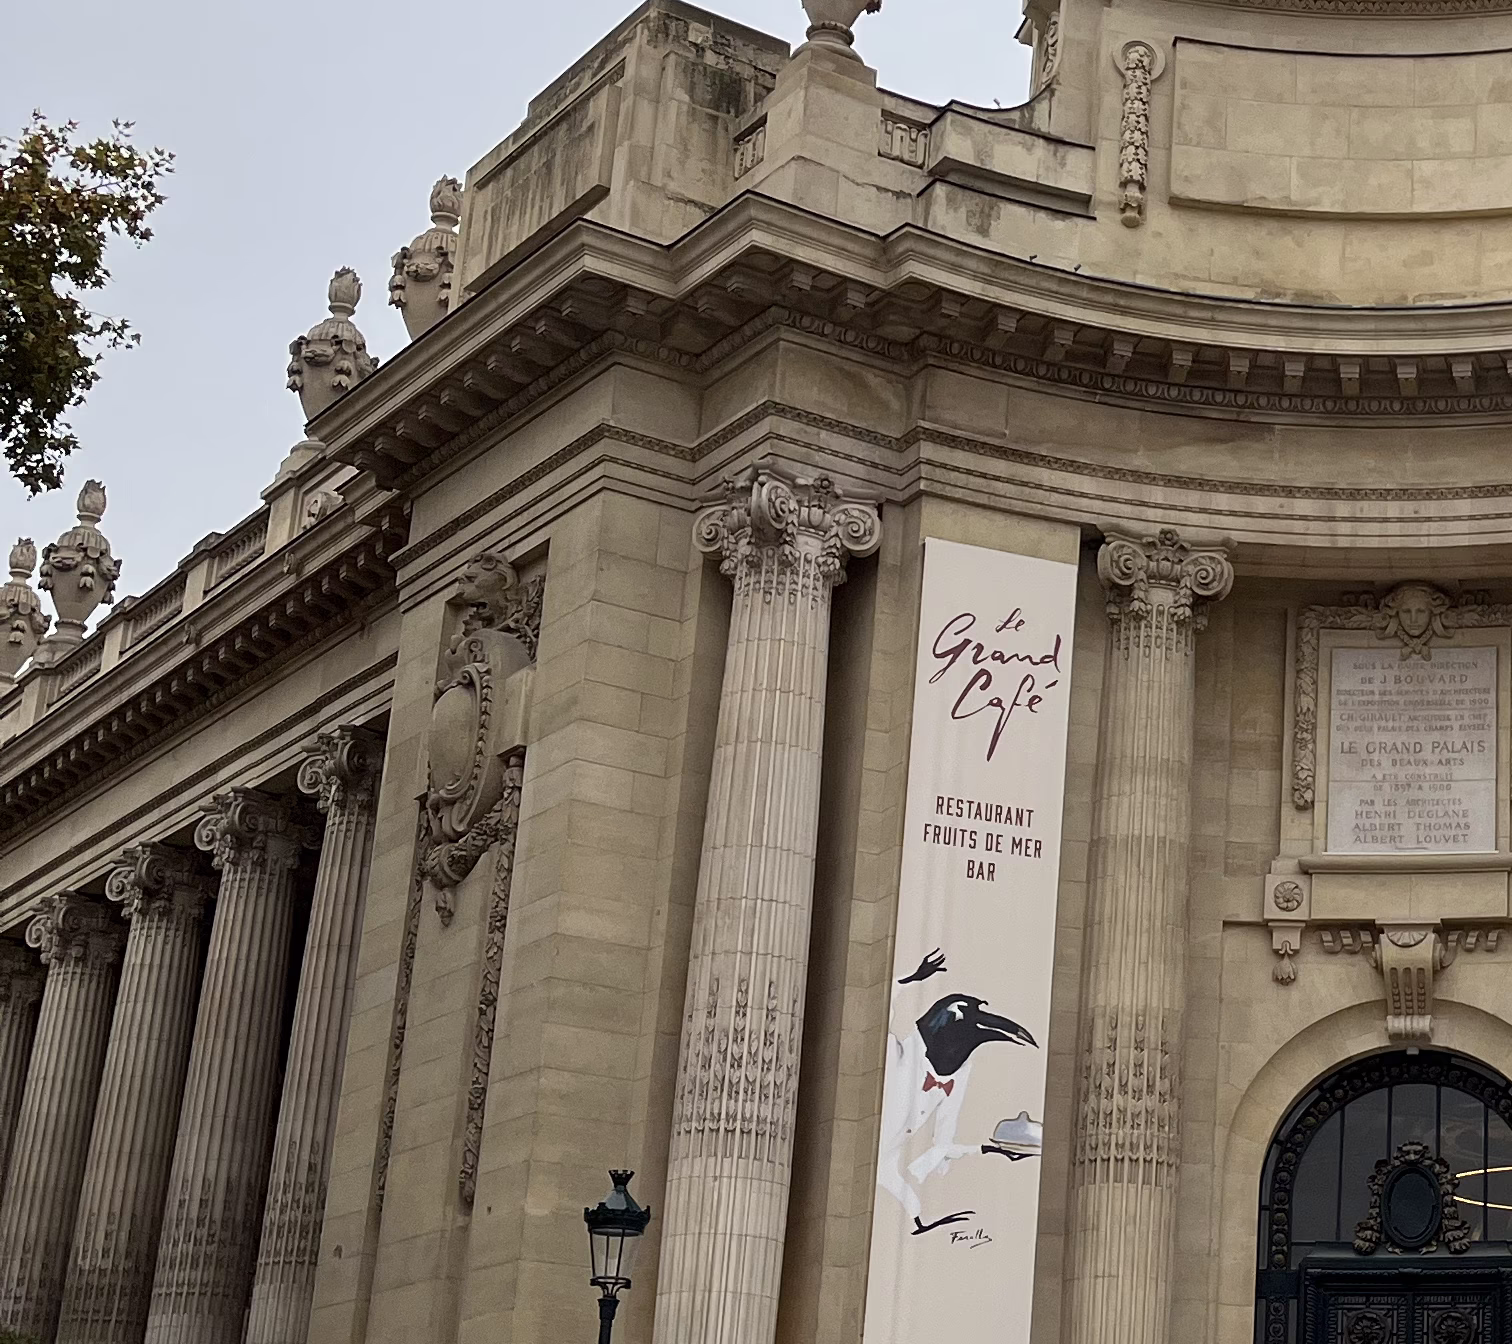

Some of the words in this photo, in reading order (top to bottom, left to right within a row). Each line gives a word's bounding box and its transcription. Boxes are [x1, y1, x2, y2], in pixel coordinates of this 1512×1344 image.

[994, 607, 1026, 634] Le
[928, 612, 1062, 685] Grand
[1360, 676, 1374, 685] DE
[1393, 674, 1469, 685] BOUVARD
[1469, 697, 1490, 706] 1900
[950, 667, 1059, 763] Café
[1340, 741, 1358, 754] LE
[1365, 741, 1423, 754] GRAND
[1431, 739, 1486, 754] PALAIS
[1360, 758, 1382, 767] DES
[1428, 783, 1452, 792] 1900
[1358, 798, 1375, 807] PAR
[1382, 798, 1397, 807] LES
[935, 795, 1035, 829] RESTAURANT
[1354, 809, 1397, 820] HENRI
[1406, 809, 1470, 820] DEGLANE
[1352, 822, 1404, 832] ALBERT
[1414, 821, 1471, 832] THOMAS
[923, 822, 978, 851] FRUITS
[985, 832, 1004, 854] DE
[1010, 836, 1043, 859] MER
[1353, 834, 1405, 844] ALBERT
[1416, 833, 1469, 844] LOUVET
[966, 859, 996, 882] BAR
